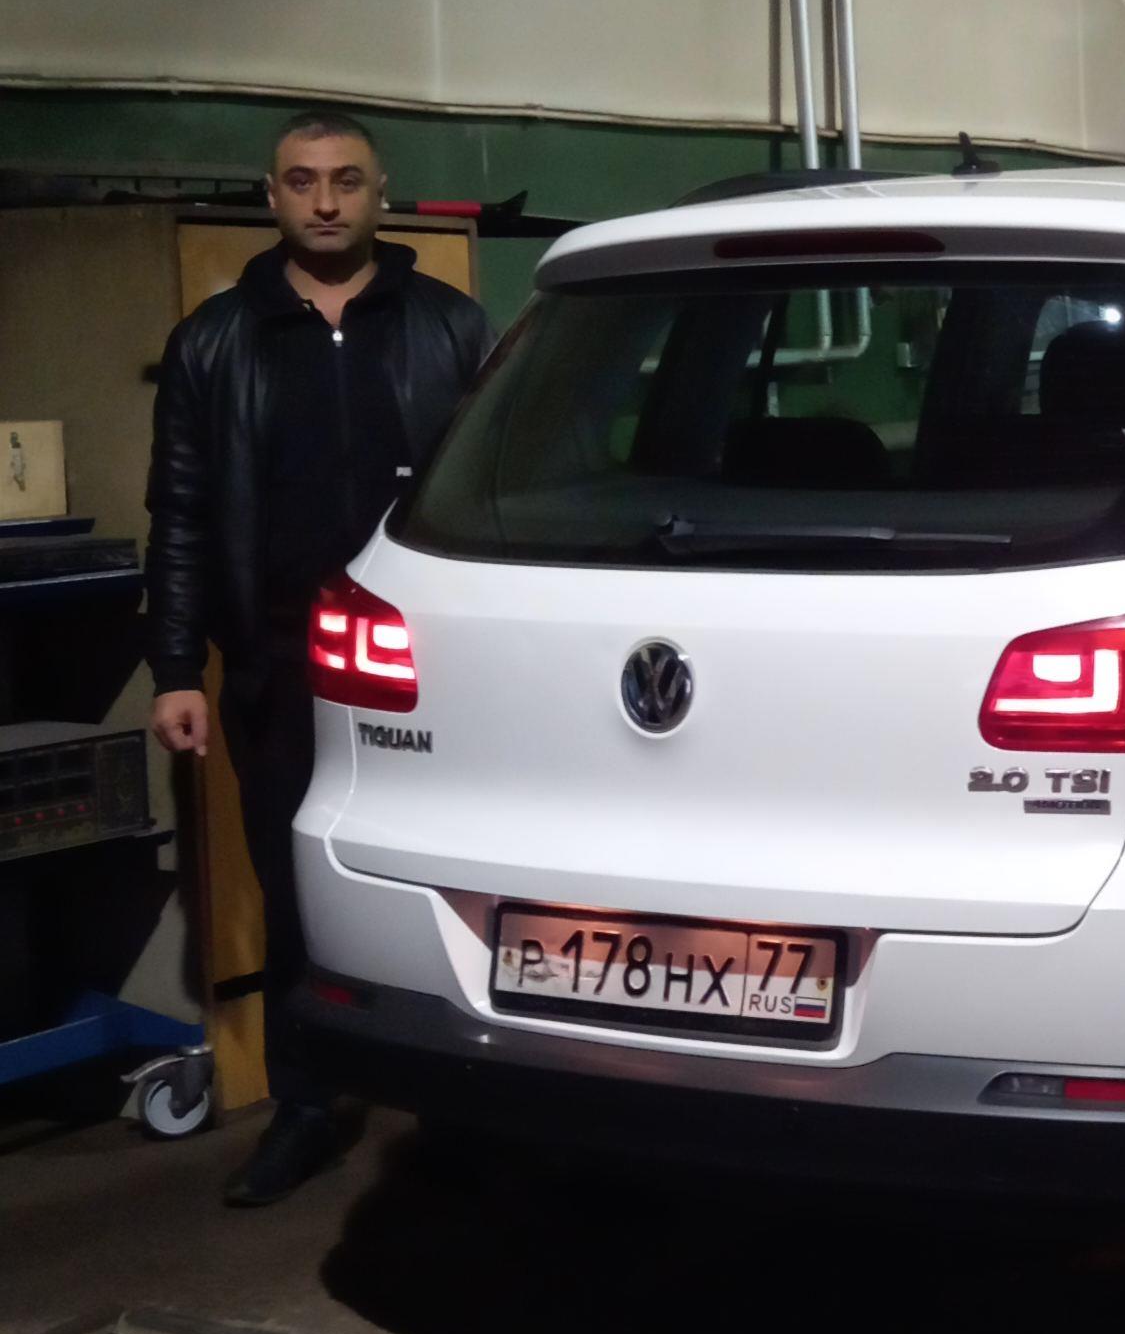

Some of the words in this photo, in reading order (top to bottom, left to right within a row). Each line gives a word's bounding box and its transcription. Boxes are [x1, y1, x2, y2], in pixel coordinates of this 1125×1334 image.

[357, 721, 433, 754] TIGUAN
[967, 766, 1030, 793] 2.0
[1045, 768, 1111, 794] TSI
[756, 940, 816, 995] 77
[749, 993, 793, 1014] RUS
